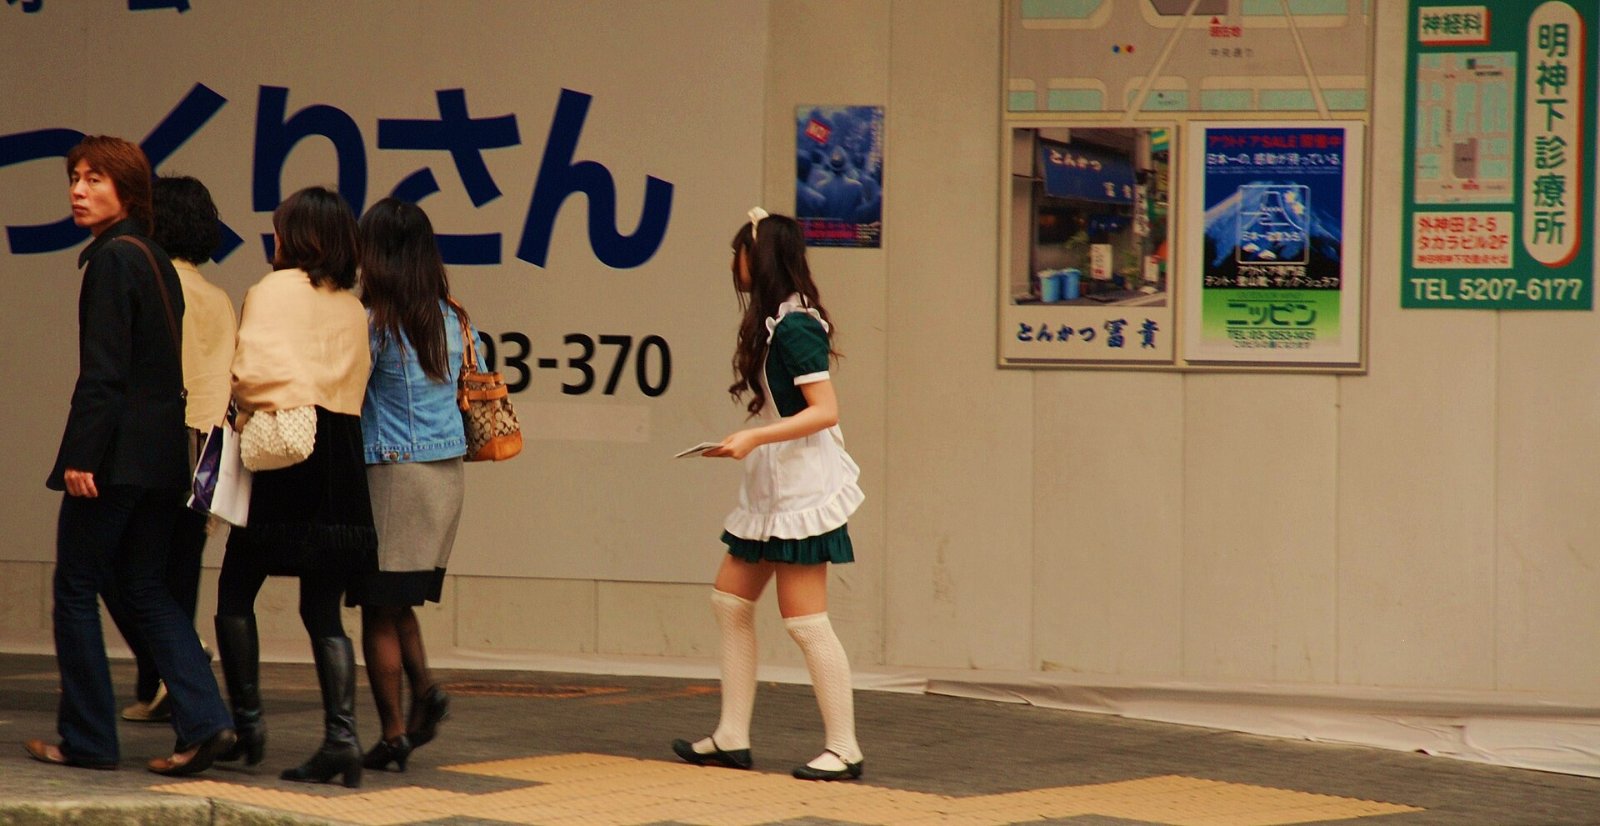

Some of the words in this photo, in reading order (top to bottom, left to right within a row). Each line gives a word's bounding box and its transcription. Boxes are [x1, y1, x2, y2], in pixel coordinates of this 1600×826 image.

[1532, 23, 1569, 245] 明神下診療所
[1411, 278, 1454, 300] TEL
[1459, 278, 1582, 300] 5207-6177
[1226, 302, 1316, 326] ニッピン
